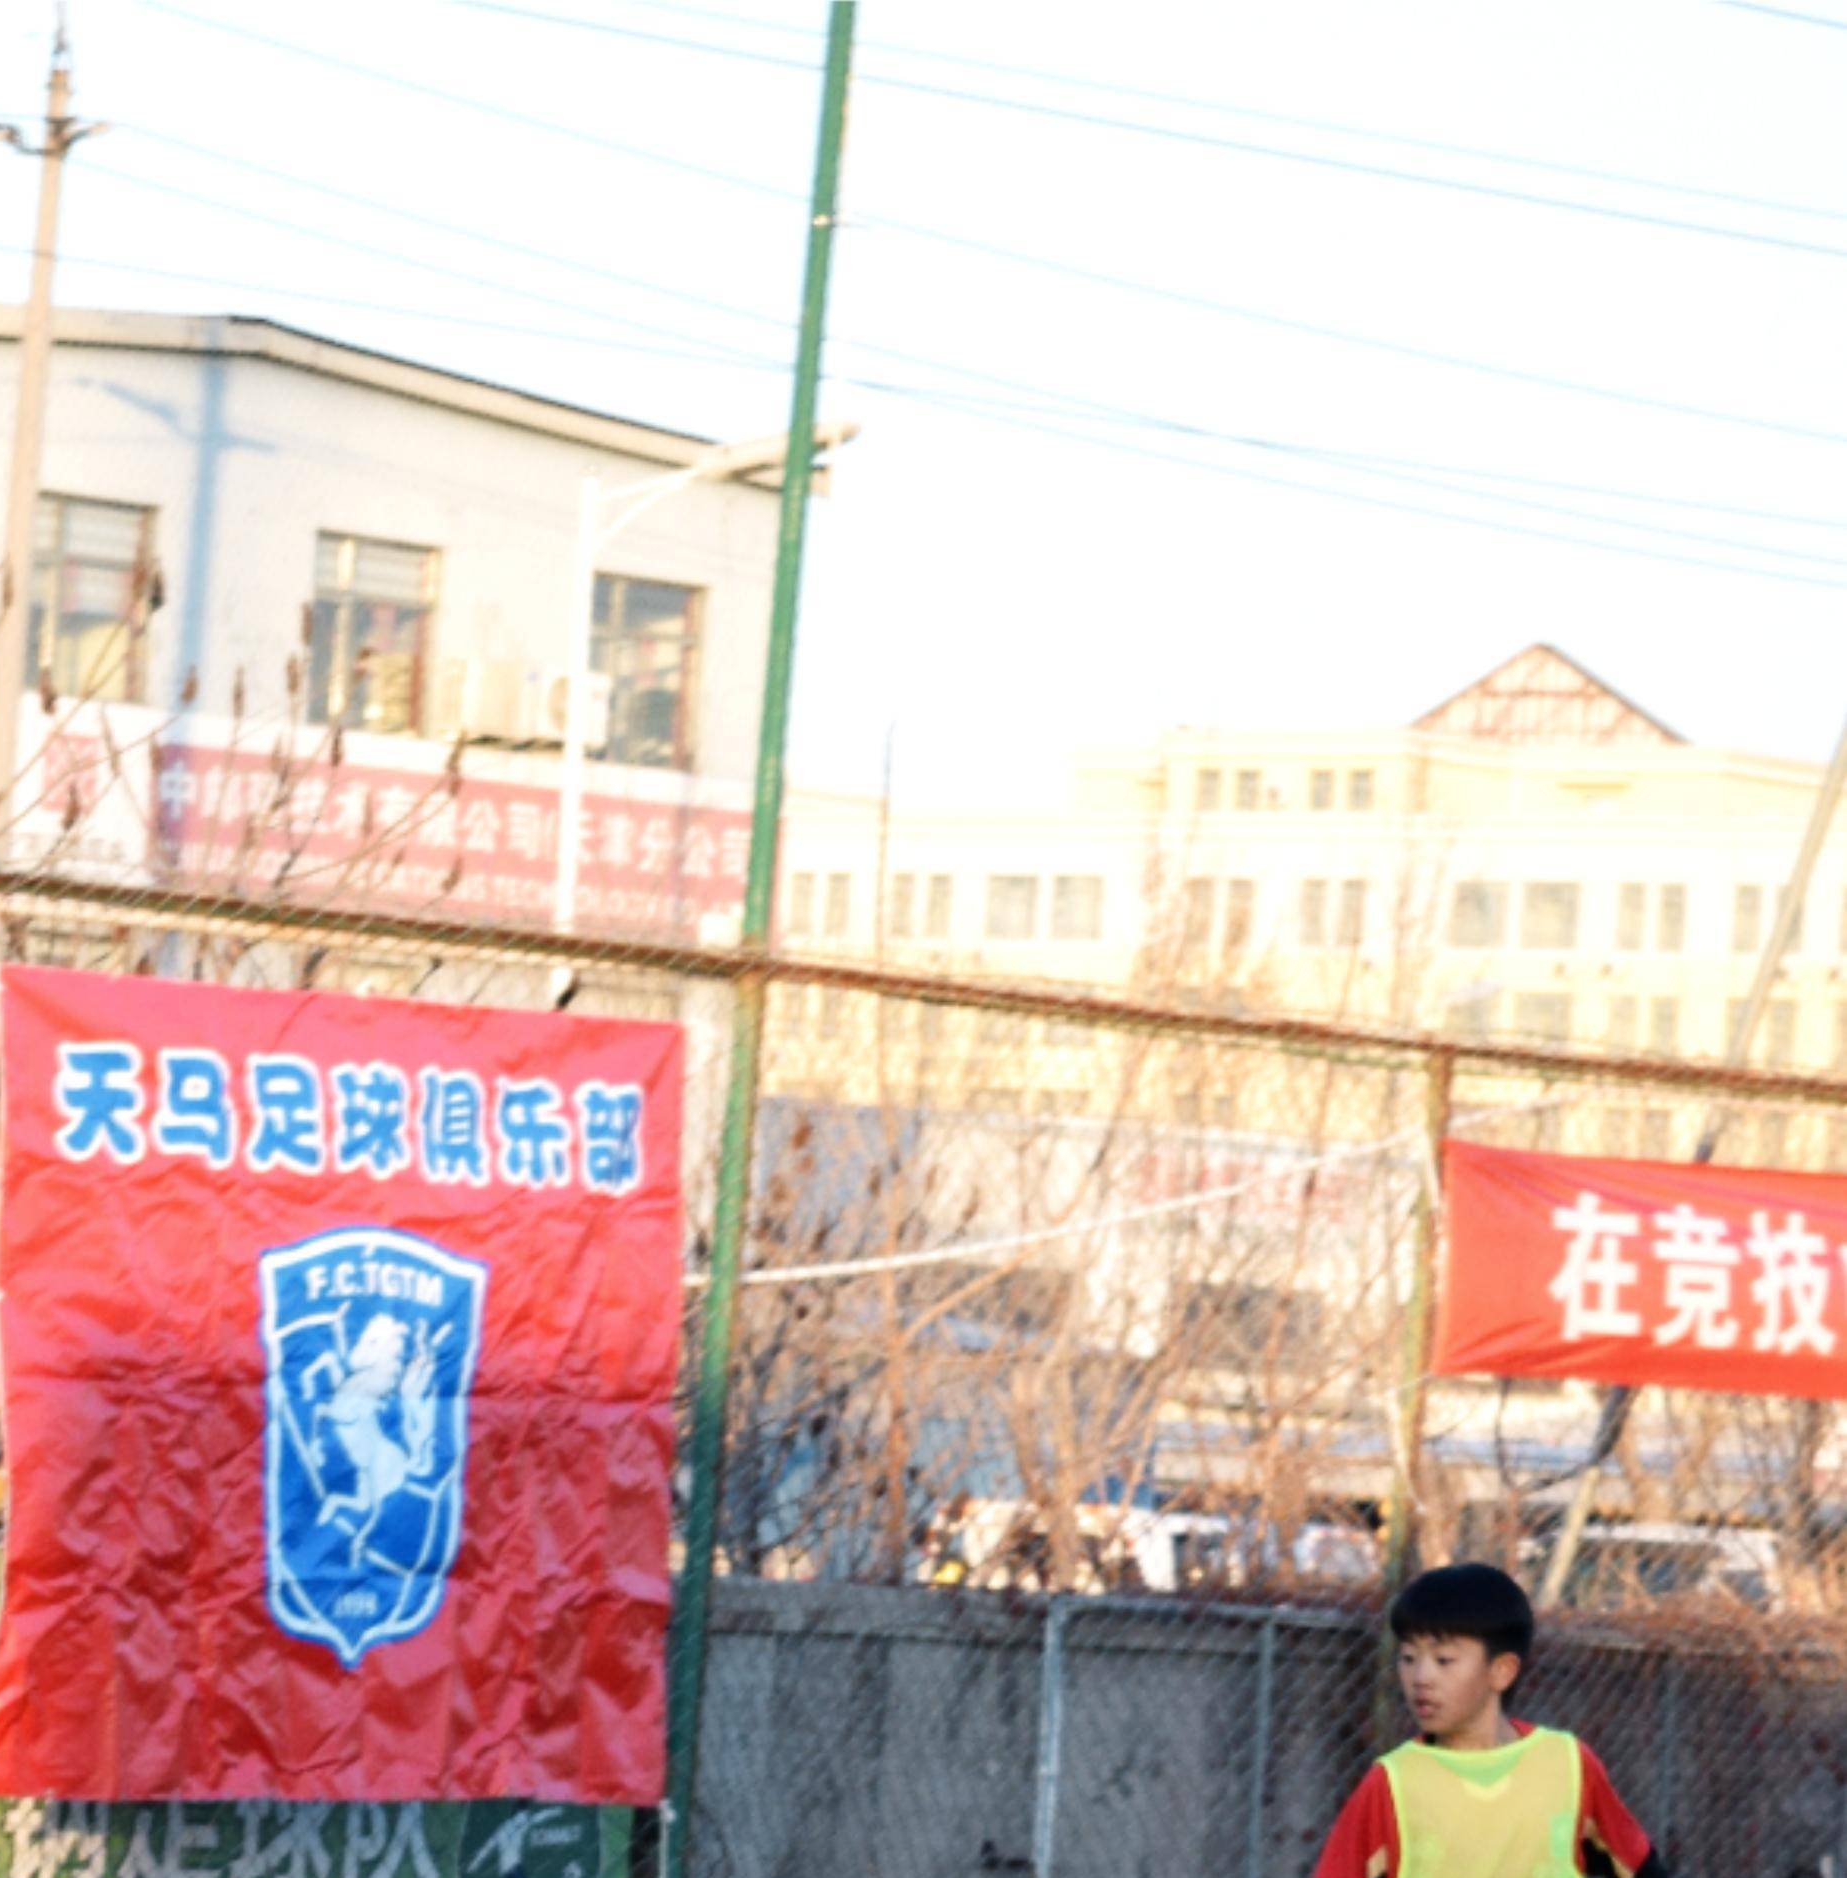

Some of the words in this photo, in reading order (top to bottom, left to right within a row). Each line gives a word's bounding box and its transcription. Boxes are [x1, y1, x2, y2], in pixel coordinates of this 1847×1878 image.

[55, 1042, 644, 1197] 天马足球俱乐部
[1549, 1191, 1847, 1354] 在竞技
